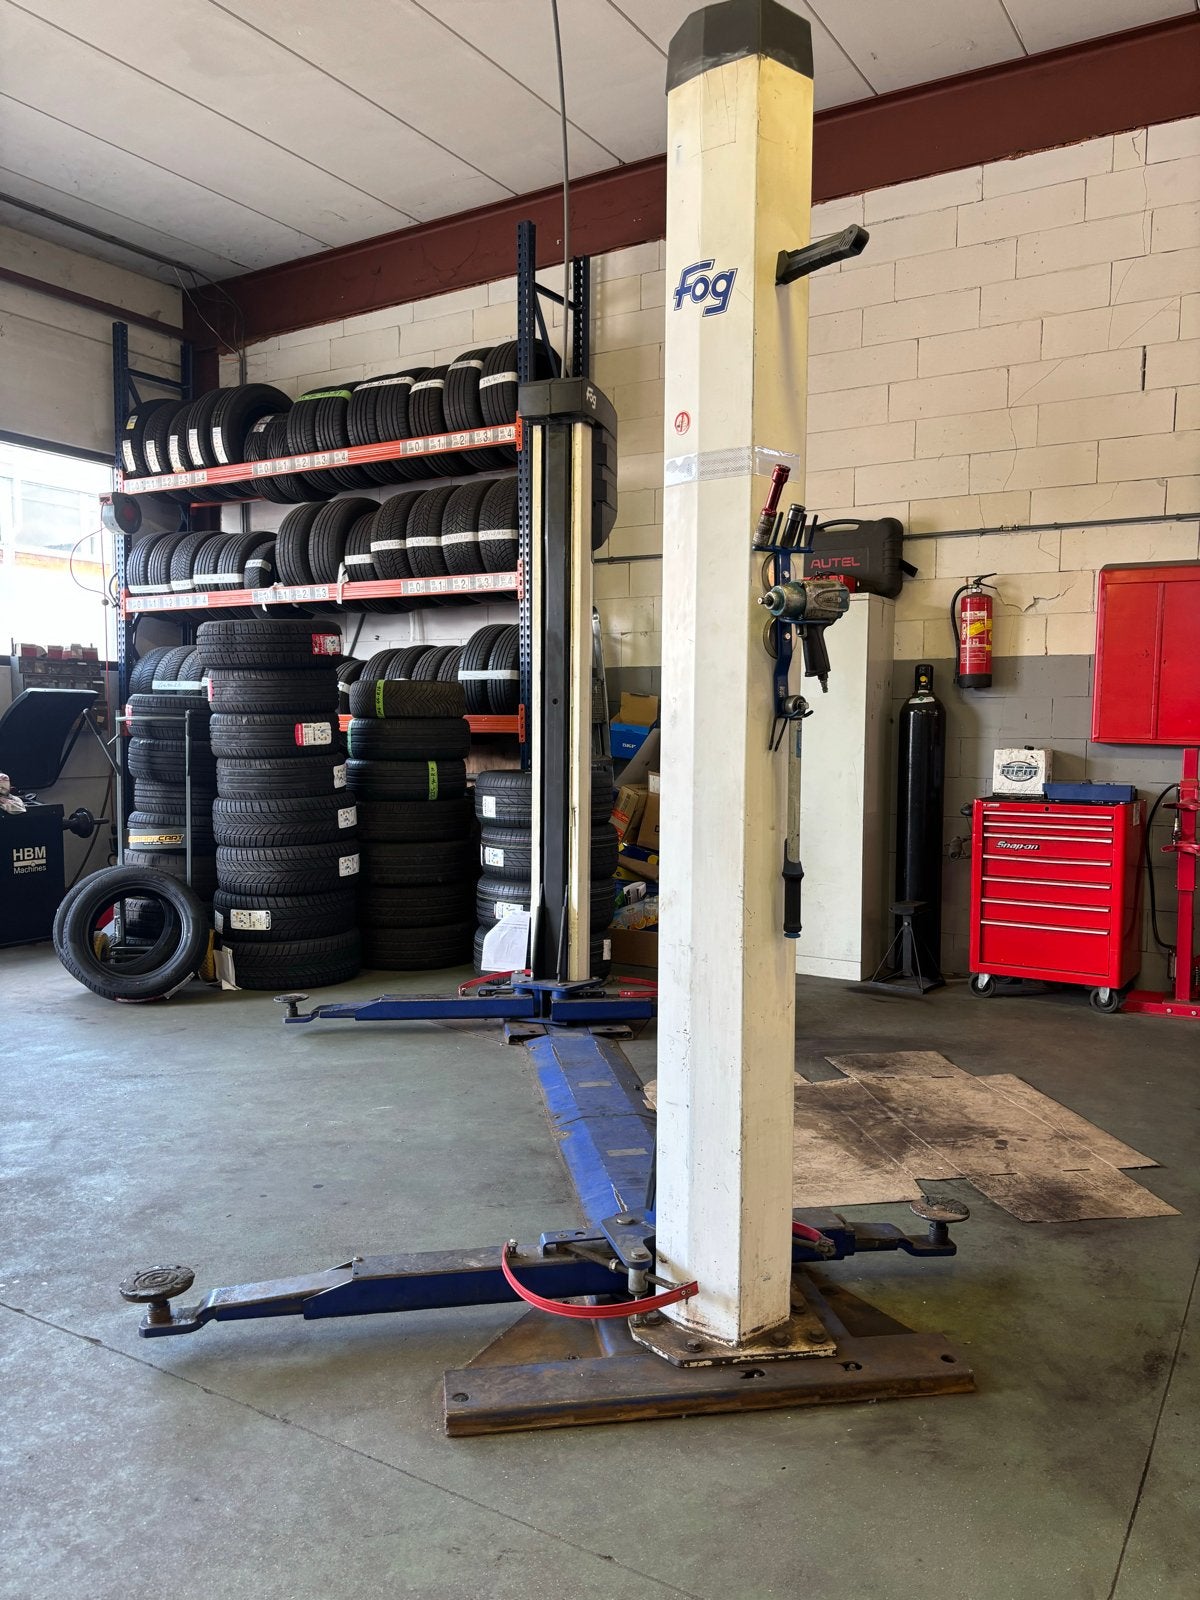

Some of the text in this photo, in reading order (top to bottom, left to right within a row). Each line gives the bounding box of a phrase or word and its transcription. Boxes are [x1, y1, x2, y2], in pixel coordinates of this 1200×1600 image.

[810, 557, 860, 569] AUTEL
[996, 840, 1039, 851] Snap-on
[13, 846, 46, 861] HBM
[13, 865, 47, 875] Machines
